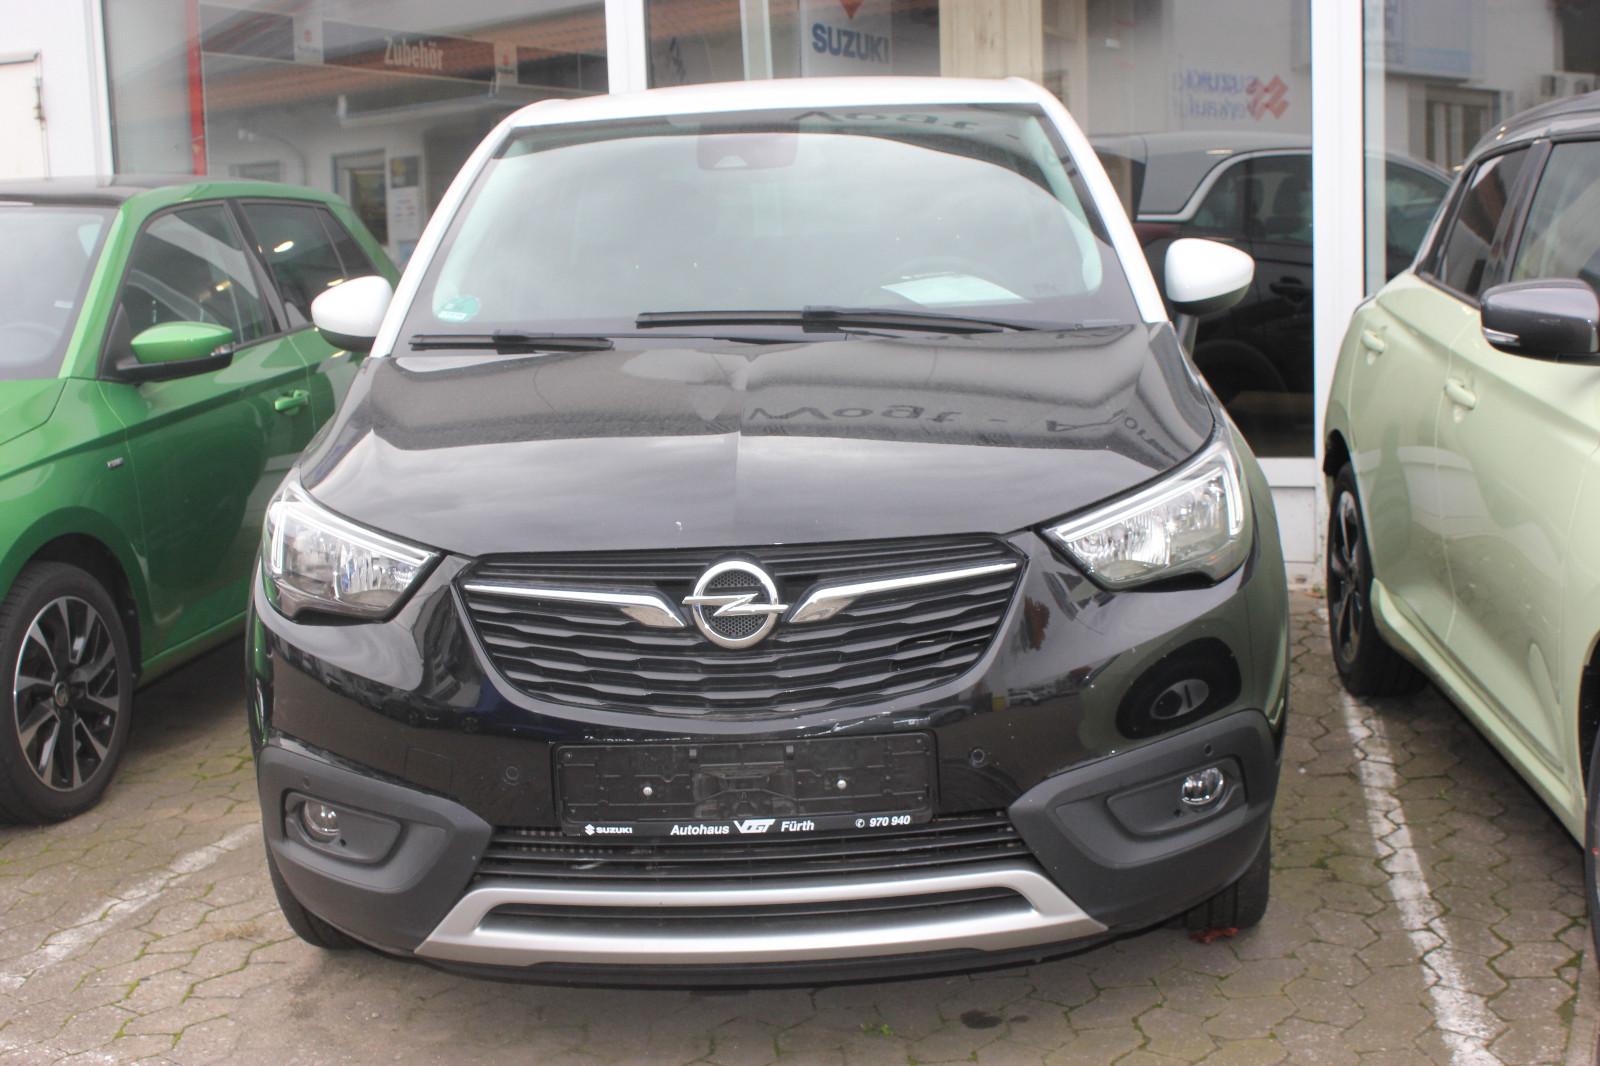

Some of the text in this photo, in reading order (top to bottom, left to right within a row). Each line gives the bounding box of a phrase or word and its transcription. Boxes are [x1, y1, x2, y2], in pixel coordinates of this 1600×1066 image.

[812, 22, 889, 63] SUZUKI
[384, 34, 443, 70] Zubehör
[670, 824, 730, 836] Autohaus
[781, 820, 815, 832] Fürth
[869, 815, 911, 828] 970 940
[596, 826, 633, 834] SUZUKI
